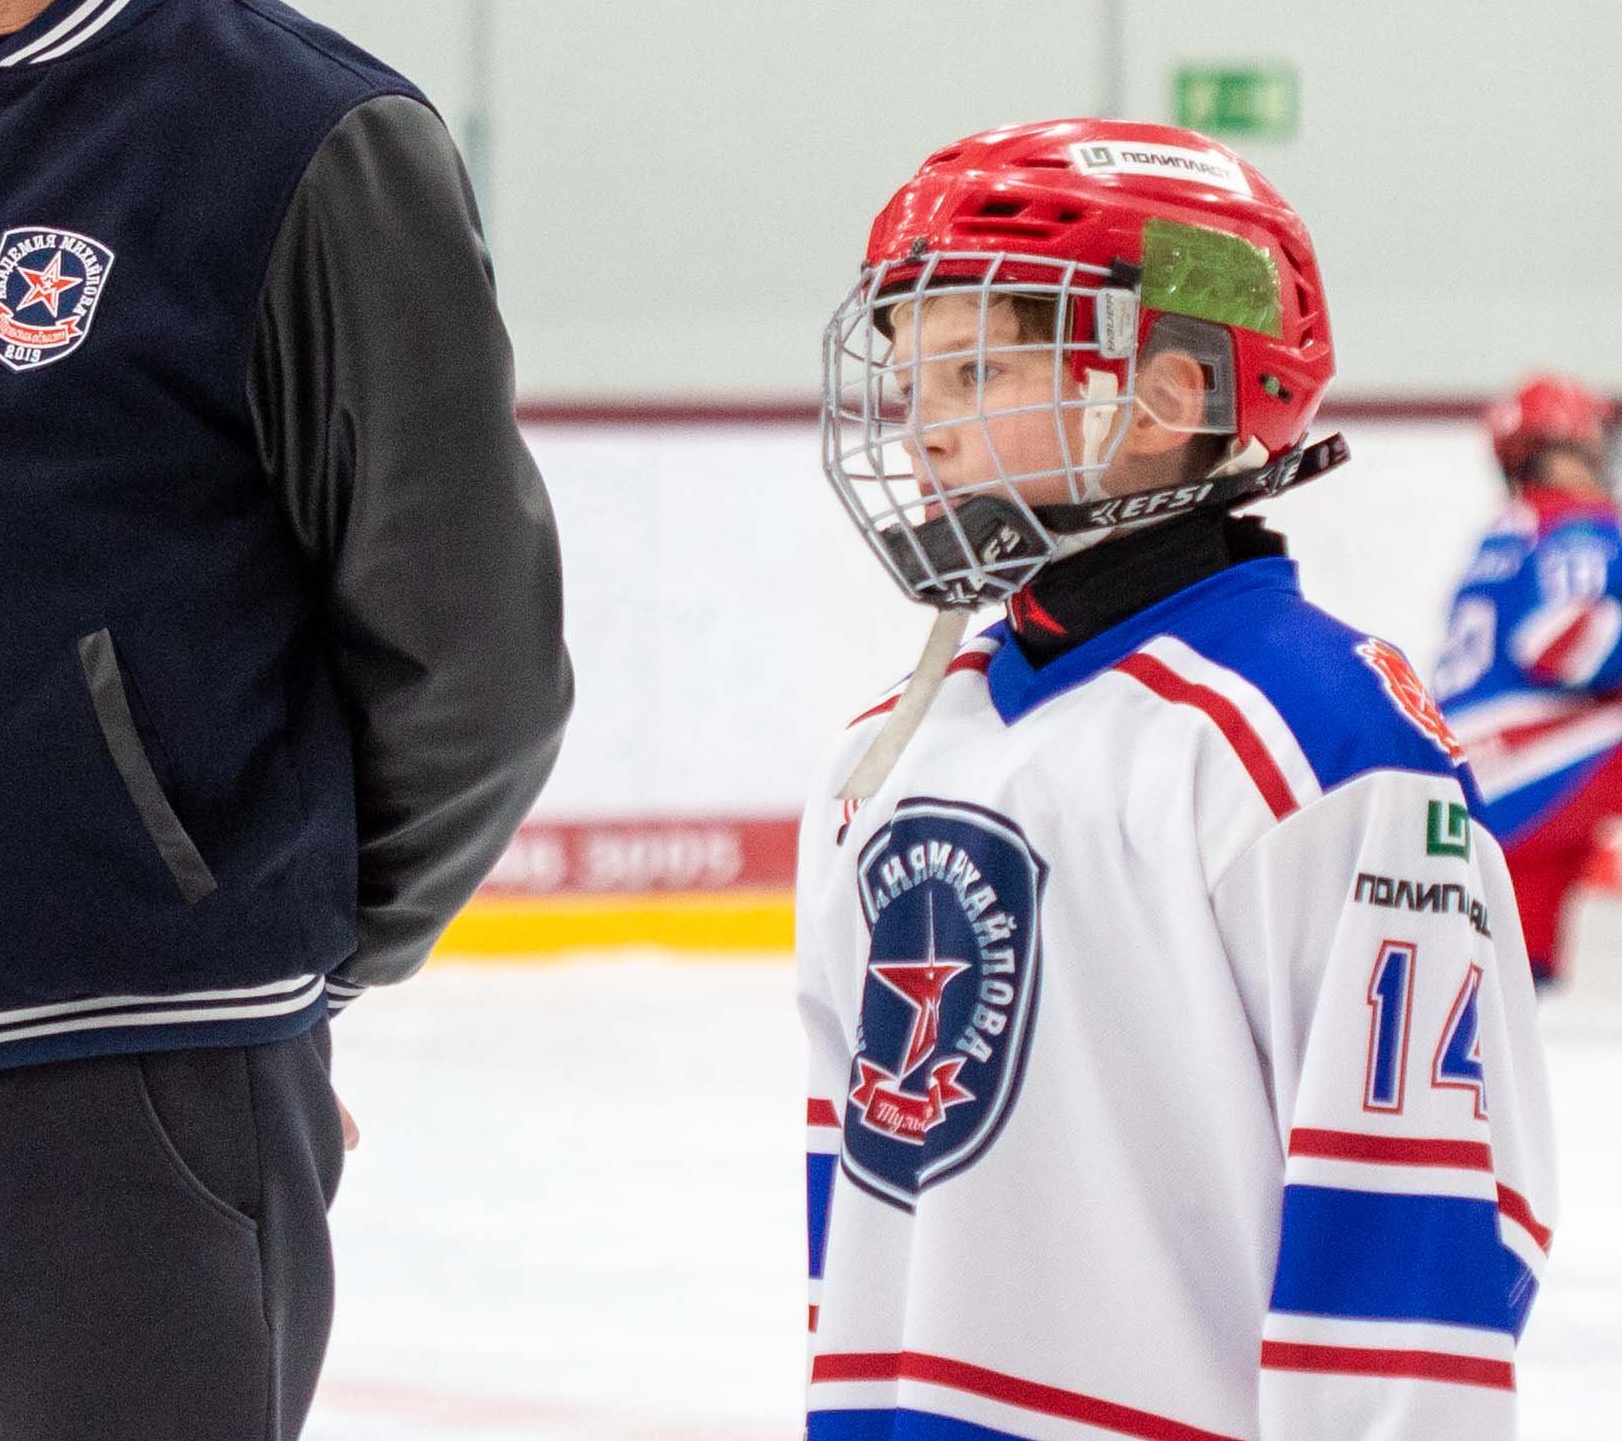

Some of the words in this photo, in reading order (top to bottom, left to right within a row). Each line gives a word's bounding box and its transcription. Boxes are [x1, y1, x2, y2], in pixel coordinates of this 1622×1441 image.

[58, 235, 104, 315] МИХАЙЛОВА
[4, 344, 42, 363] 2019
[1119, 482, 1214, 522] EFSI
[1362, 938, 1490, 1122] 14
